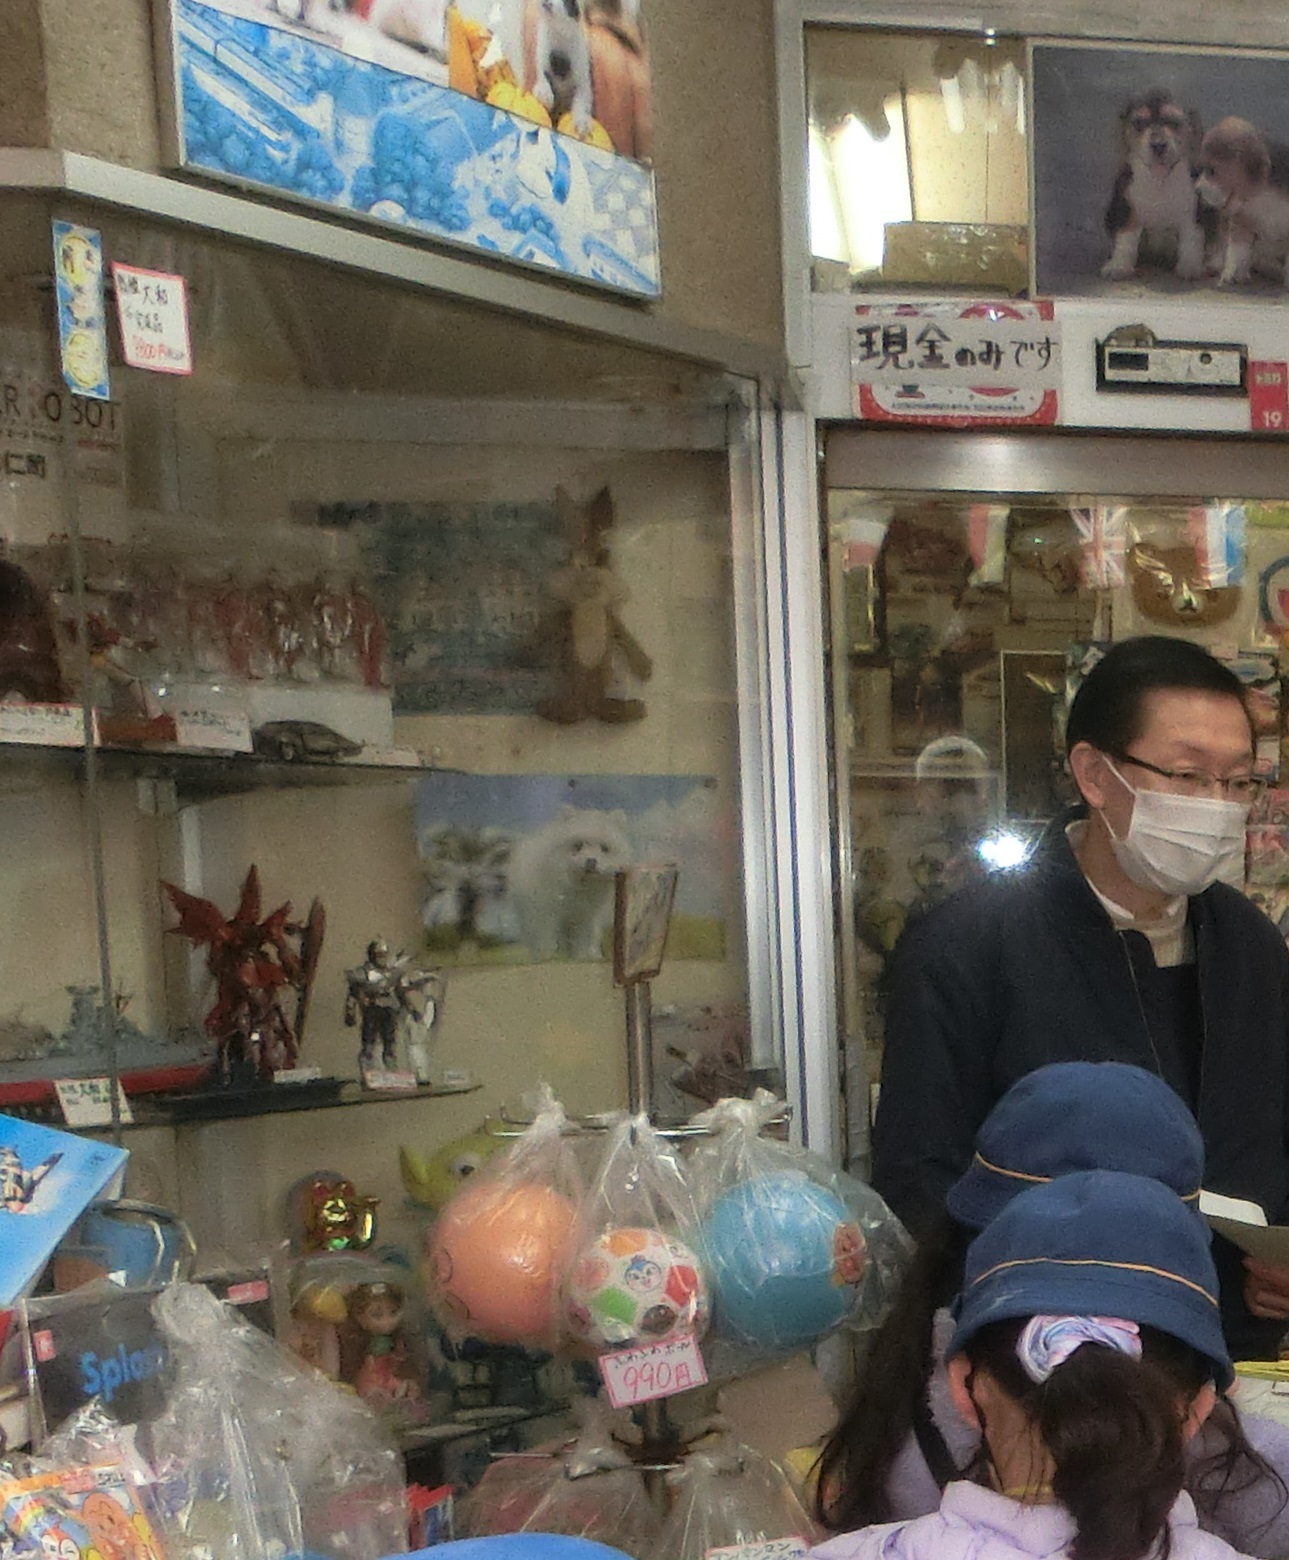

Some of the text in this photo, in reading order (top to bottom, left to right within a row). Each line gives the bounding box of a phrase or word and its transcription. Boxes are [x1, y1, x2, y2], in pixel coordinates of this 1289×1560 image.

[856, 322, 1060, 371] 現金のみです
[1262, 411, 1282, 427] 19
[624, 1362, 691, 1399] 990円
